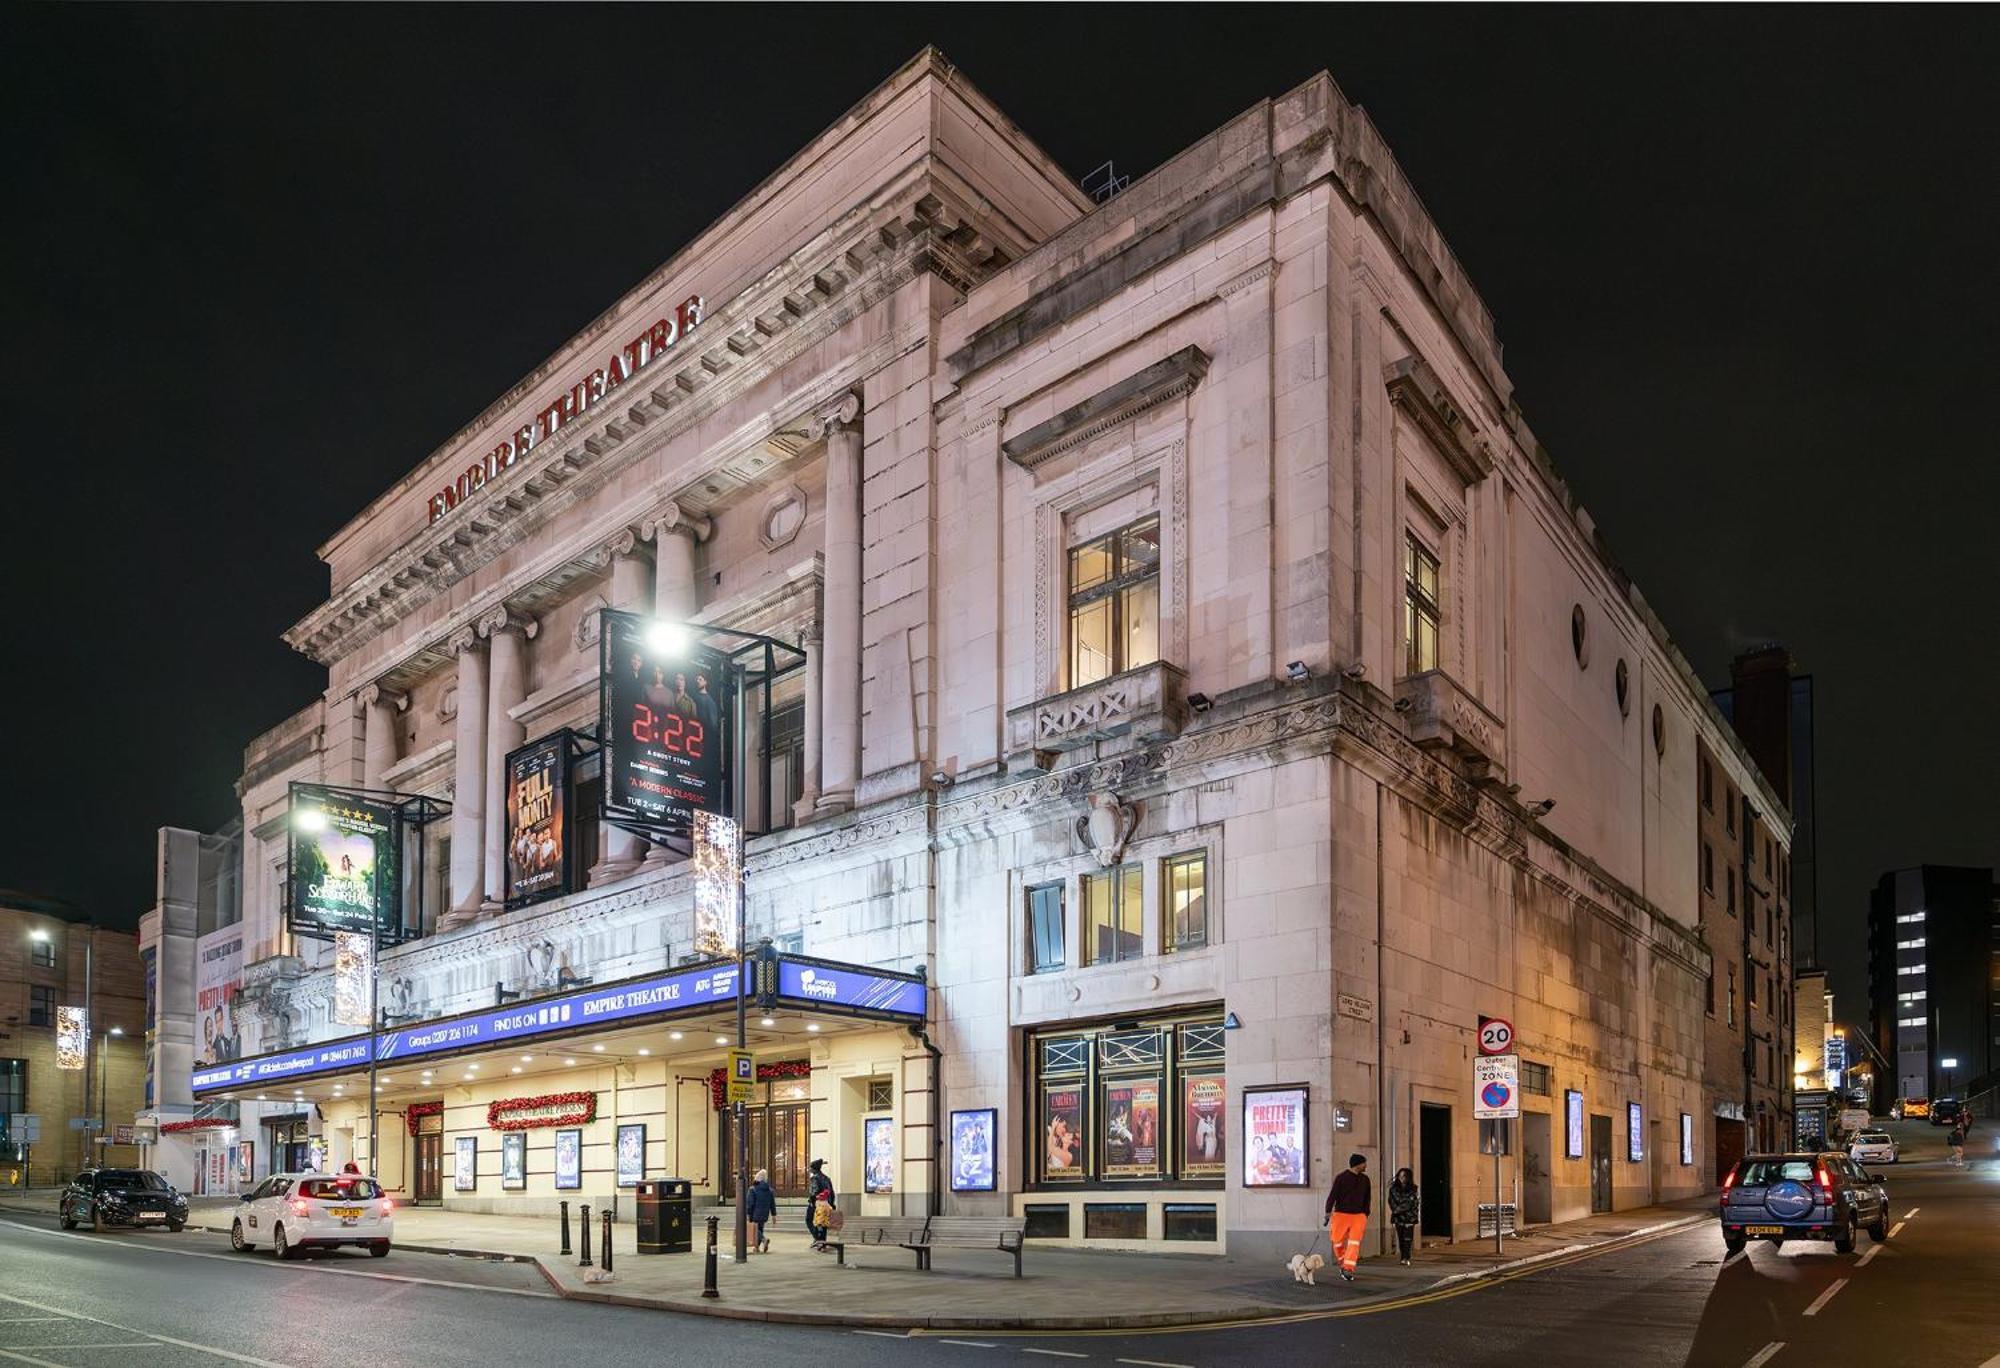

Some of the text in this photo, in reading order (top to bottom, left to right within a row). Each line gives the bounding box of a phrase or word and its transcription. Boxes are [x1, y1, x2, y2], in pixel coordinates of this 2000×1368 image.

[427, 295, 703, 526] EMPIRE THEATRE
[632, 703, 704, 758] 2:22
[517, 767, 553, 809] FULL
[639, 779, 673, 796] MODERN
[627, 795, 642, 807] TUE
[518, 791, 553, 830] MONTY
[584, 983, 680, 1016] EMPIRE THEATRE
[494, 1012, 537, 1033] FIND US ON
[408, 1035, 432, 1048] Groups
[1484, 1028, 1509, 1044] 20
[739, 1060, 750, 1076] P
[1482, 1072, 1510, 1081] ZONE
[1253, 1105, 1288, 1120] PRETTY
[1254, 1120, 1286, 1135] WOMAN
